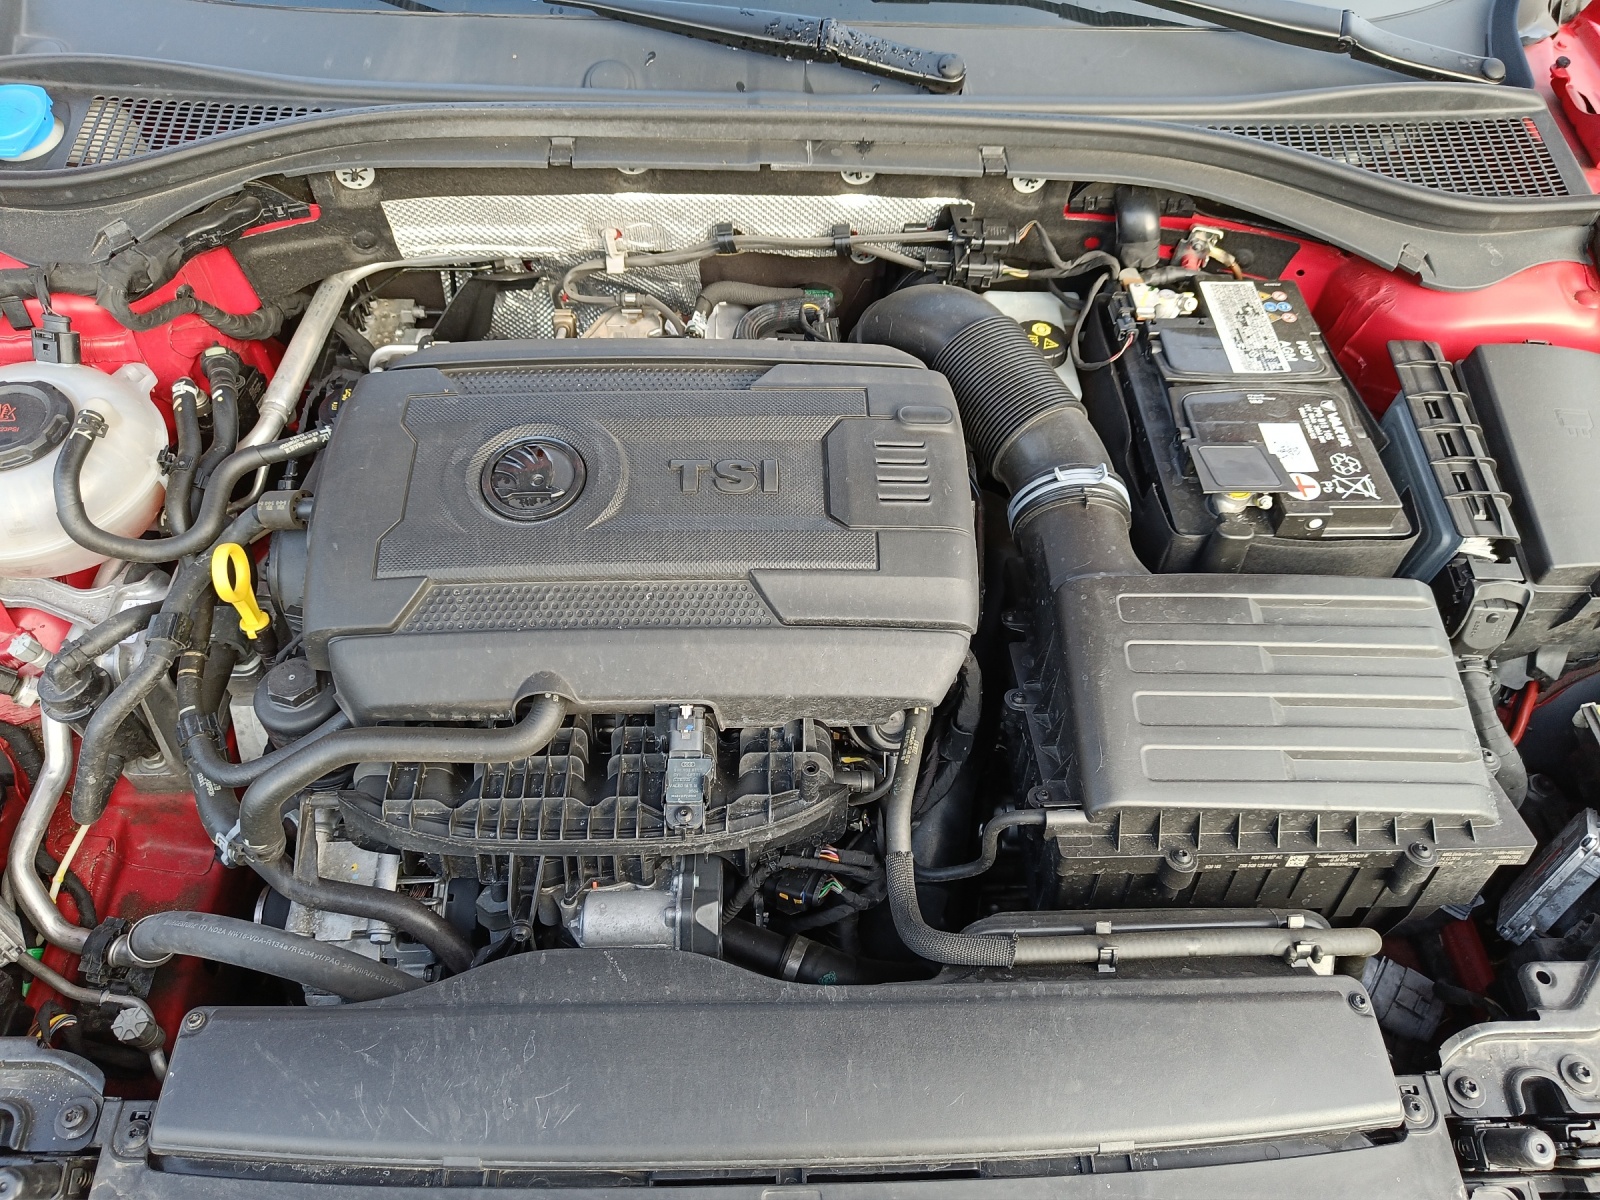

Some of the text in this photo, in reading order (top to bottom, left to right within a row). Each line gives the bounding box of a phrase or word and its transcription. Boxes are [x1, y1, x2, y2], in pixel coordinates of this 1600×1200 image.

[1278, 339, 1299, 363] AGM
[1296, 340, 1316, 363] AGM
[1327, 411, 1353, 447] VARTA
[667, 458, 780, 495] TSI
[1320, 480, 1335, 493] Pb
